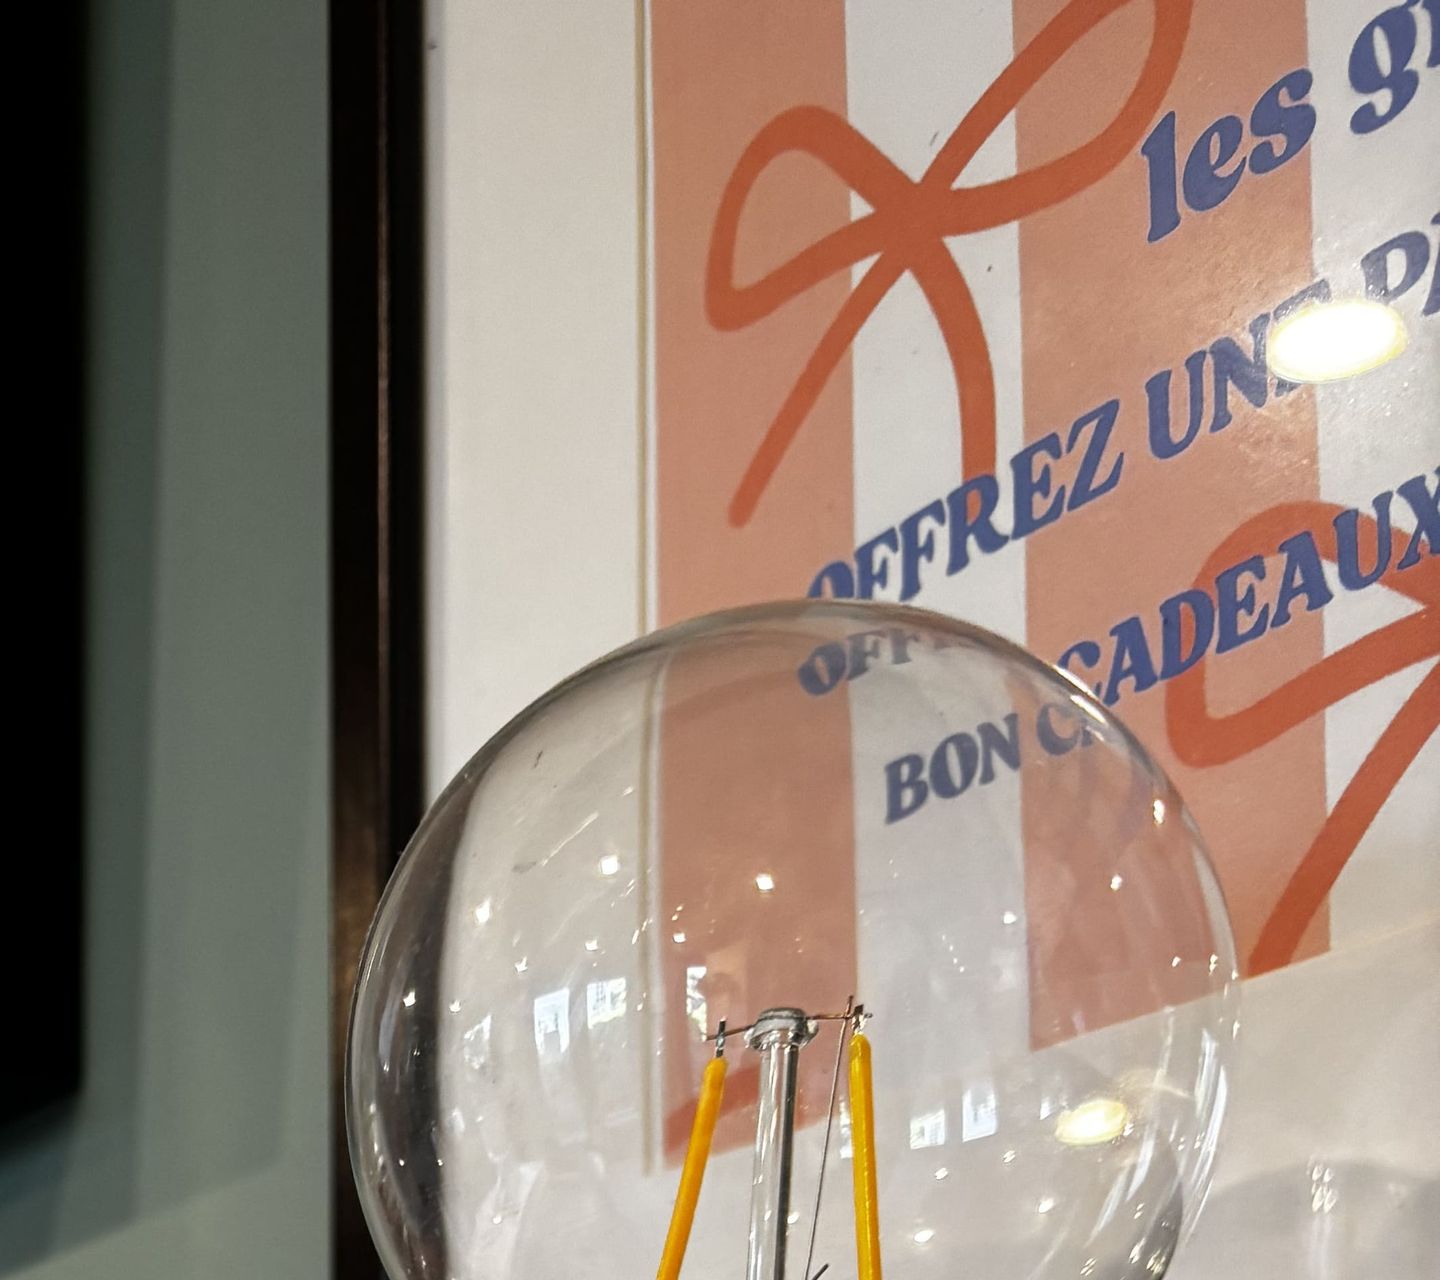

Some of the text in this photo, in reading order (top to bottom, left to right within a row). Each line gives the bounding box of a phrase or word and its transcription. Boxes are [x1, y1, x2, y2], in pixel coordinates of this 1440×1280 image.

[1141, 68, 1317, 244] les
[884, 464, 1440, 826] BON CADEAUX
